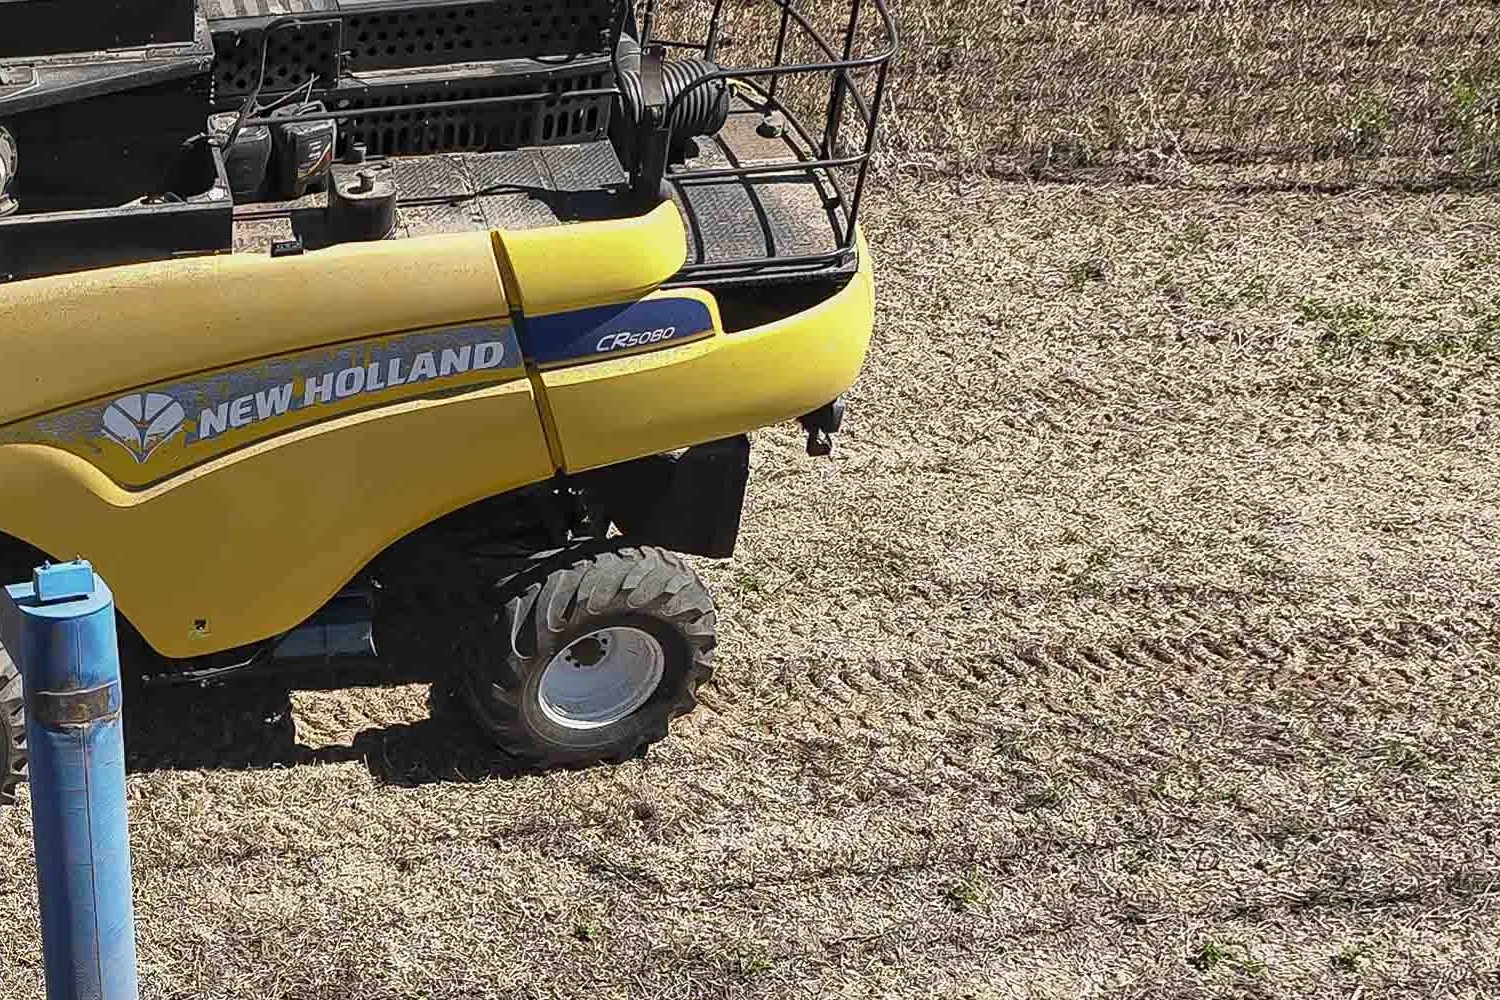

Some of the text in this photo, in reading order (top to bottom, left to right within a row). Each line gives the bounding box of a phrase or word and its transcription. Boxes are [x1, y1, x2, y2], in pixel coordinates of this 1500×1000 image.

[596, 326, 676, 352] CR5080
[199, 342, 505, 439] NEW HOLLAND
